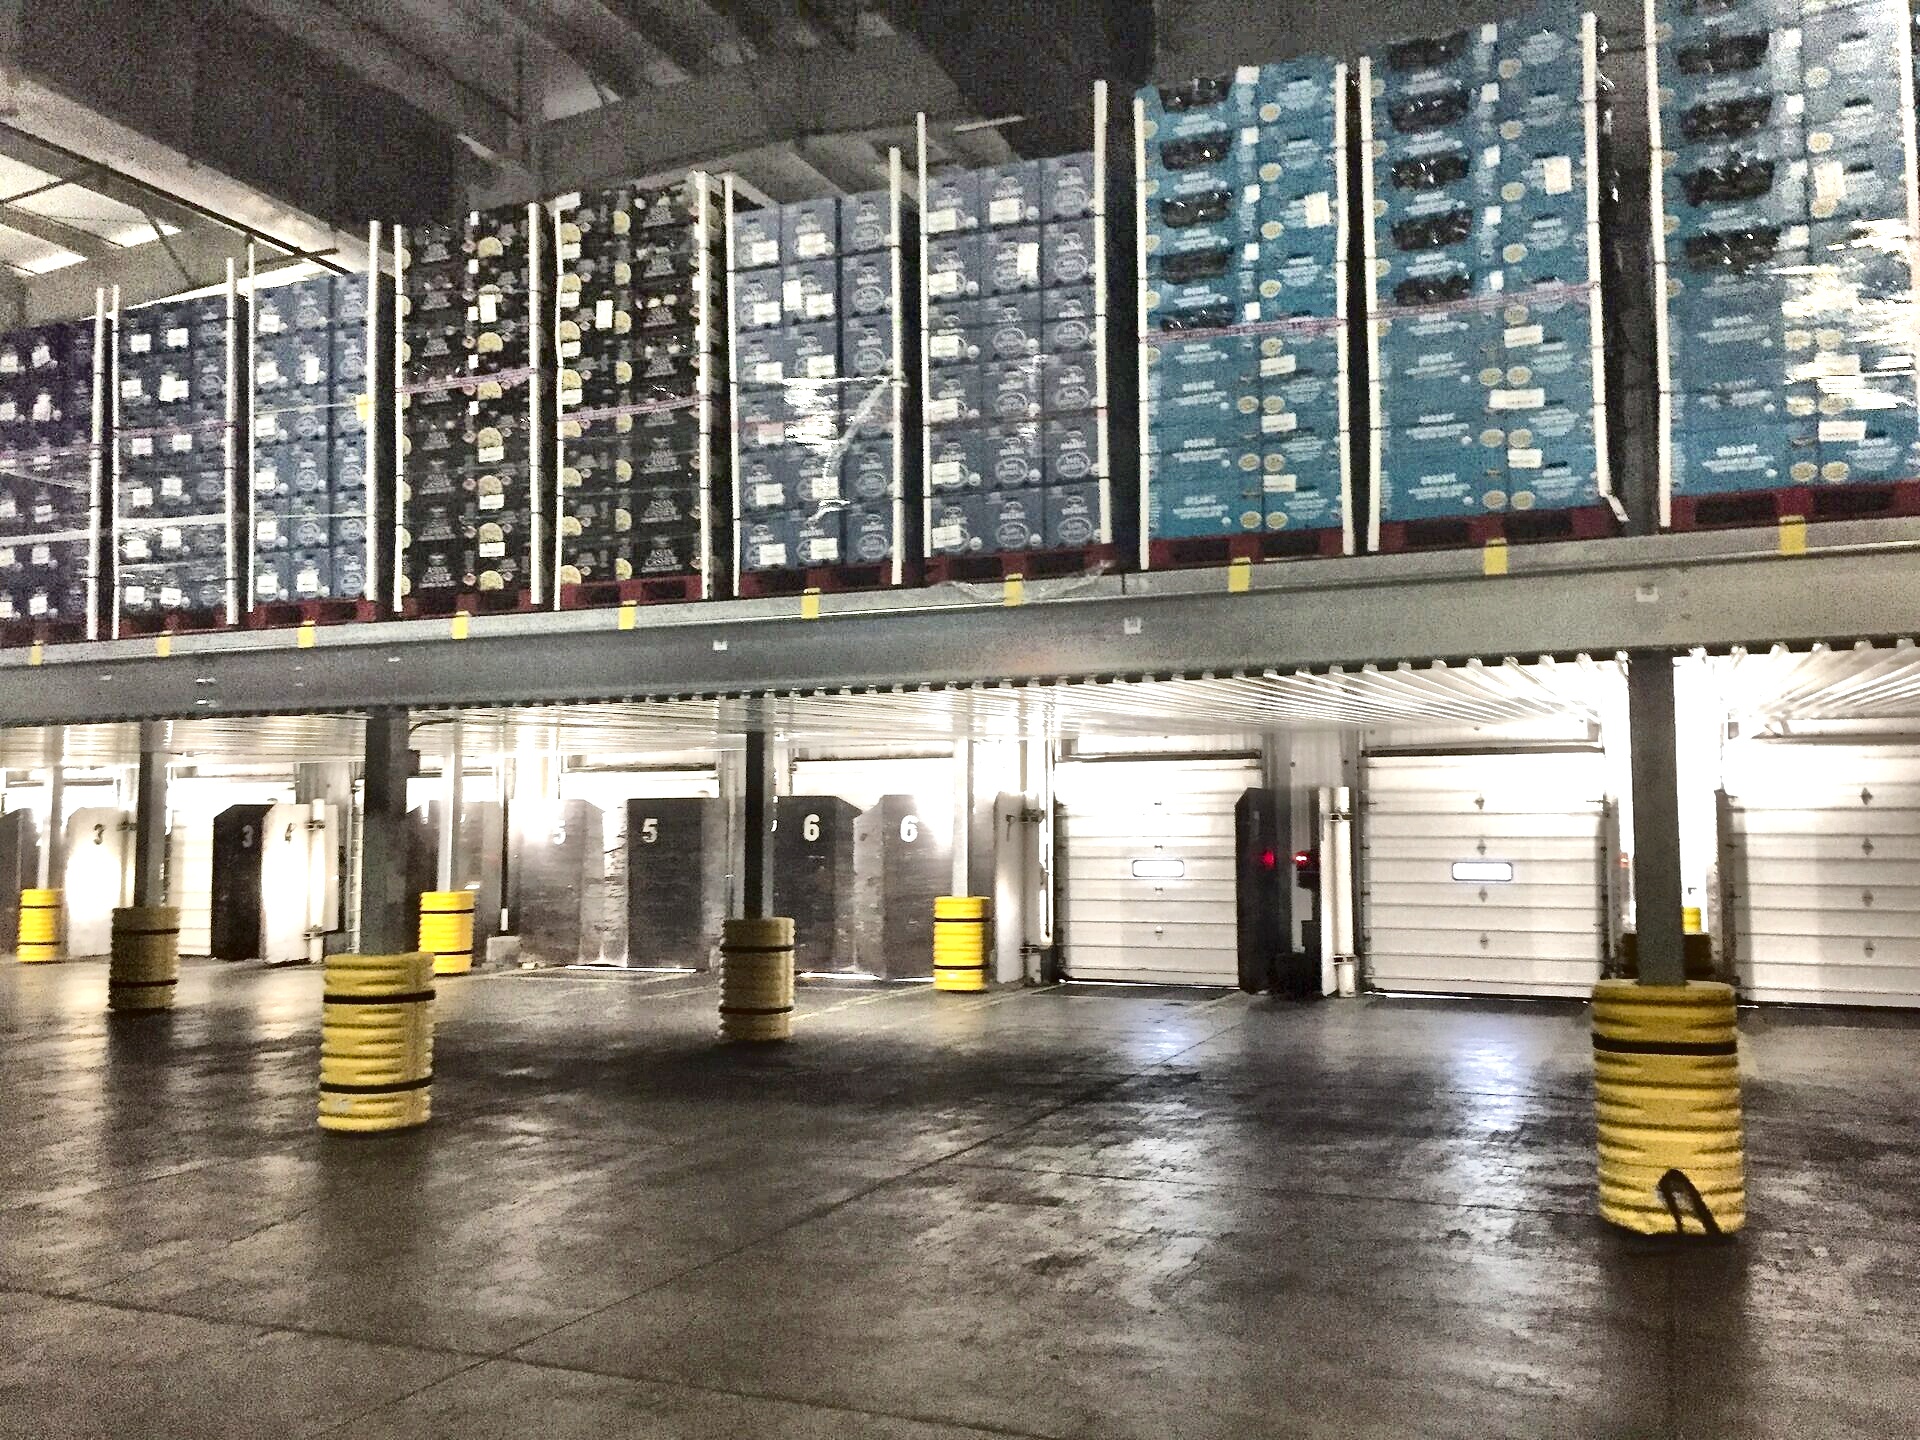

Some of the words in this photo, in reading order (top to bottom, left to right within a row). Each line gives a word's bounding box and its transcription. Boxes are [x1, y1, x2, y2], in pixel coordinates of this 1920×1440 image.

[241, 824, 254, 848] 3
[641, 818, 659, 843] 5
[803, 813, 821, 842] 6
[900, 814, 919, 843] 6
